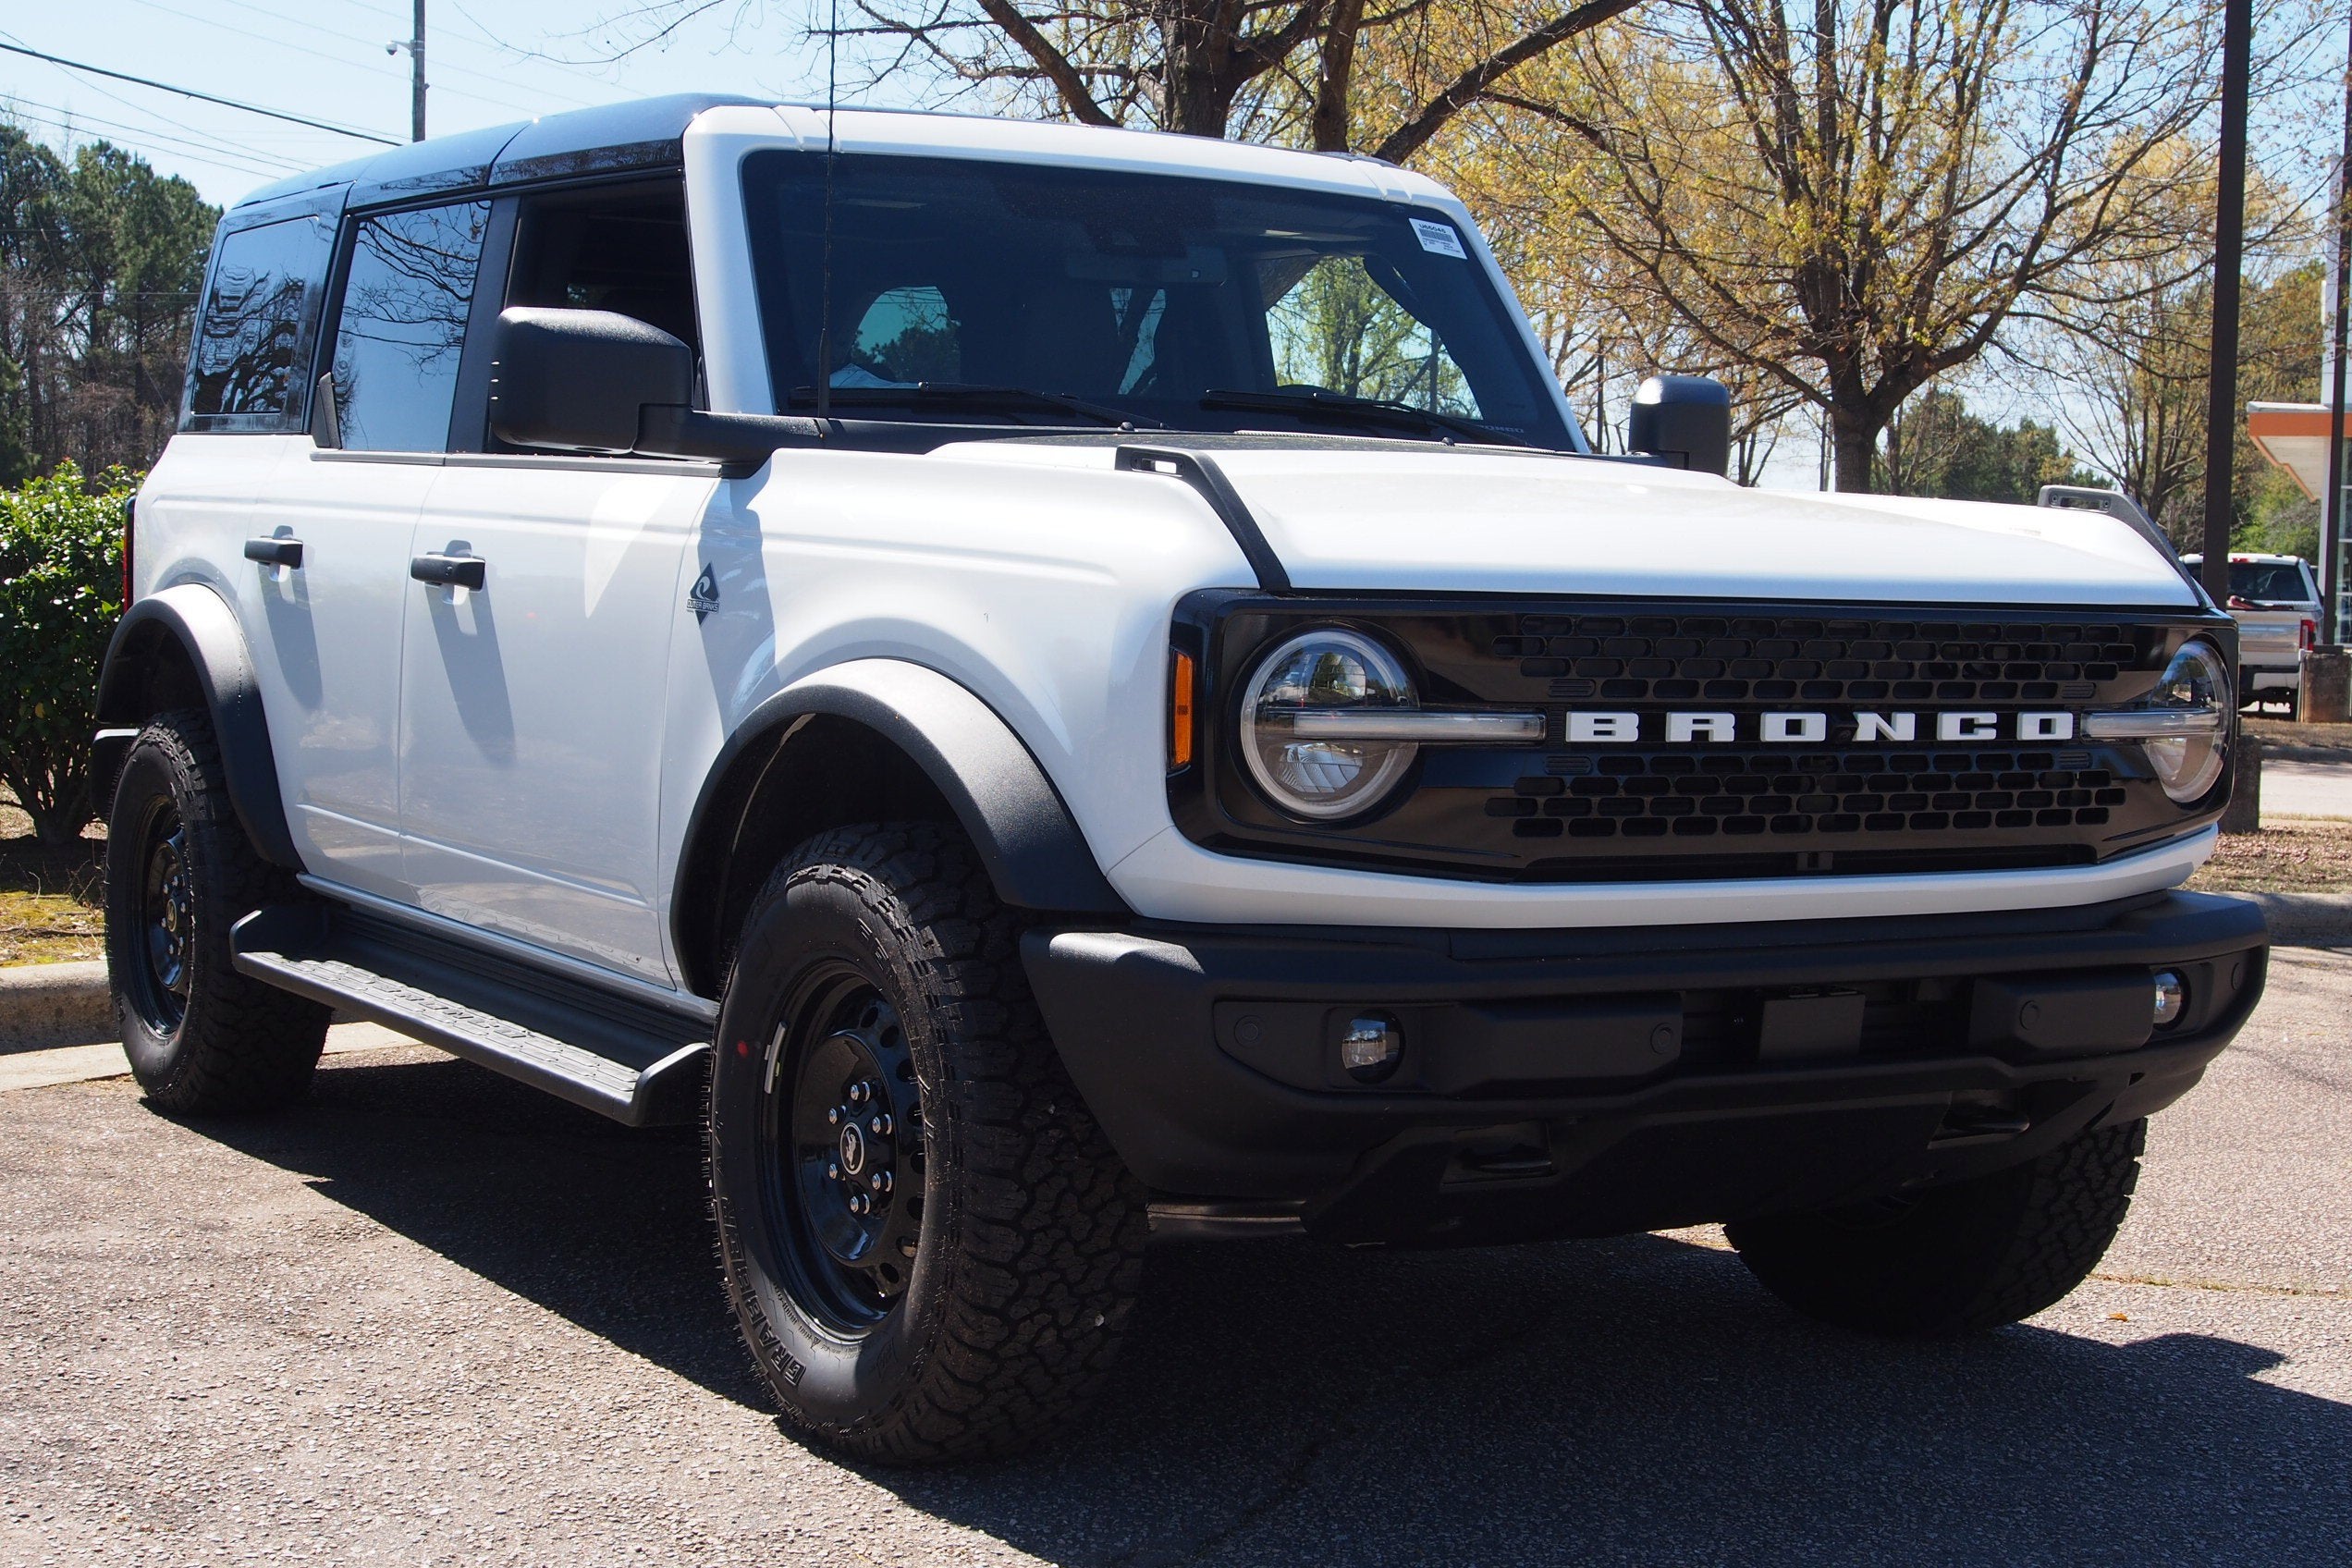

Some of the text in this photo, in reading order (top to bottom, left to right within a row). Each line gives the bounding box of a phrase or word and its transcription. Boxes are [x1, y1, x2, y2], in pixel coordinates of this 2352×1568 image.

[687, 600, 718, 611] OUTER BANKS
[1565, 711, 2074, 742] BRONCO
